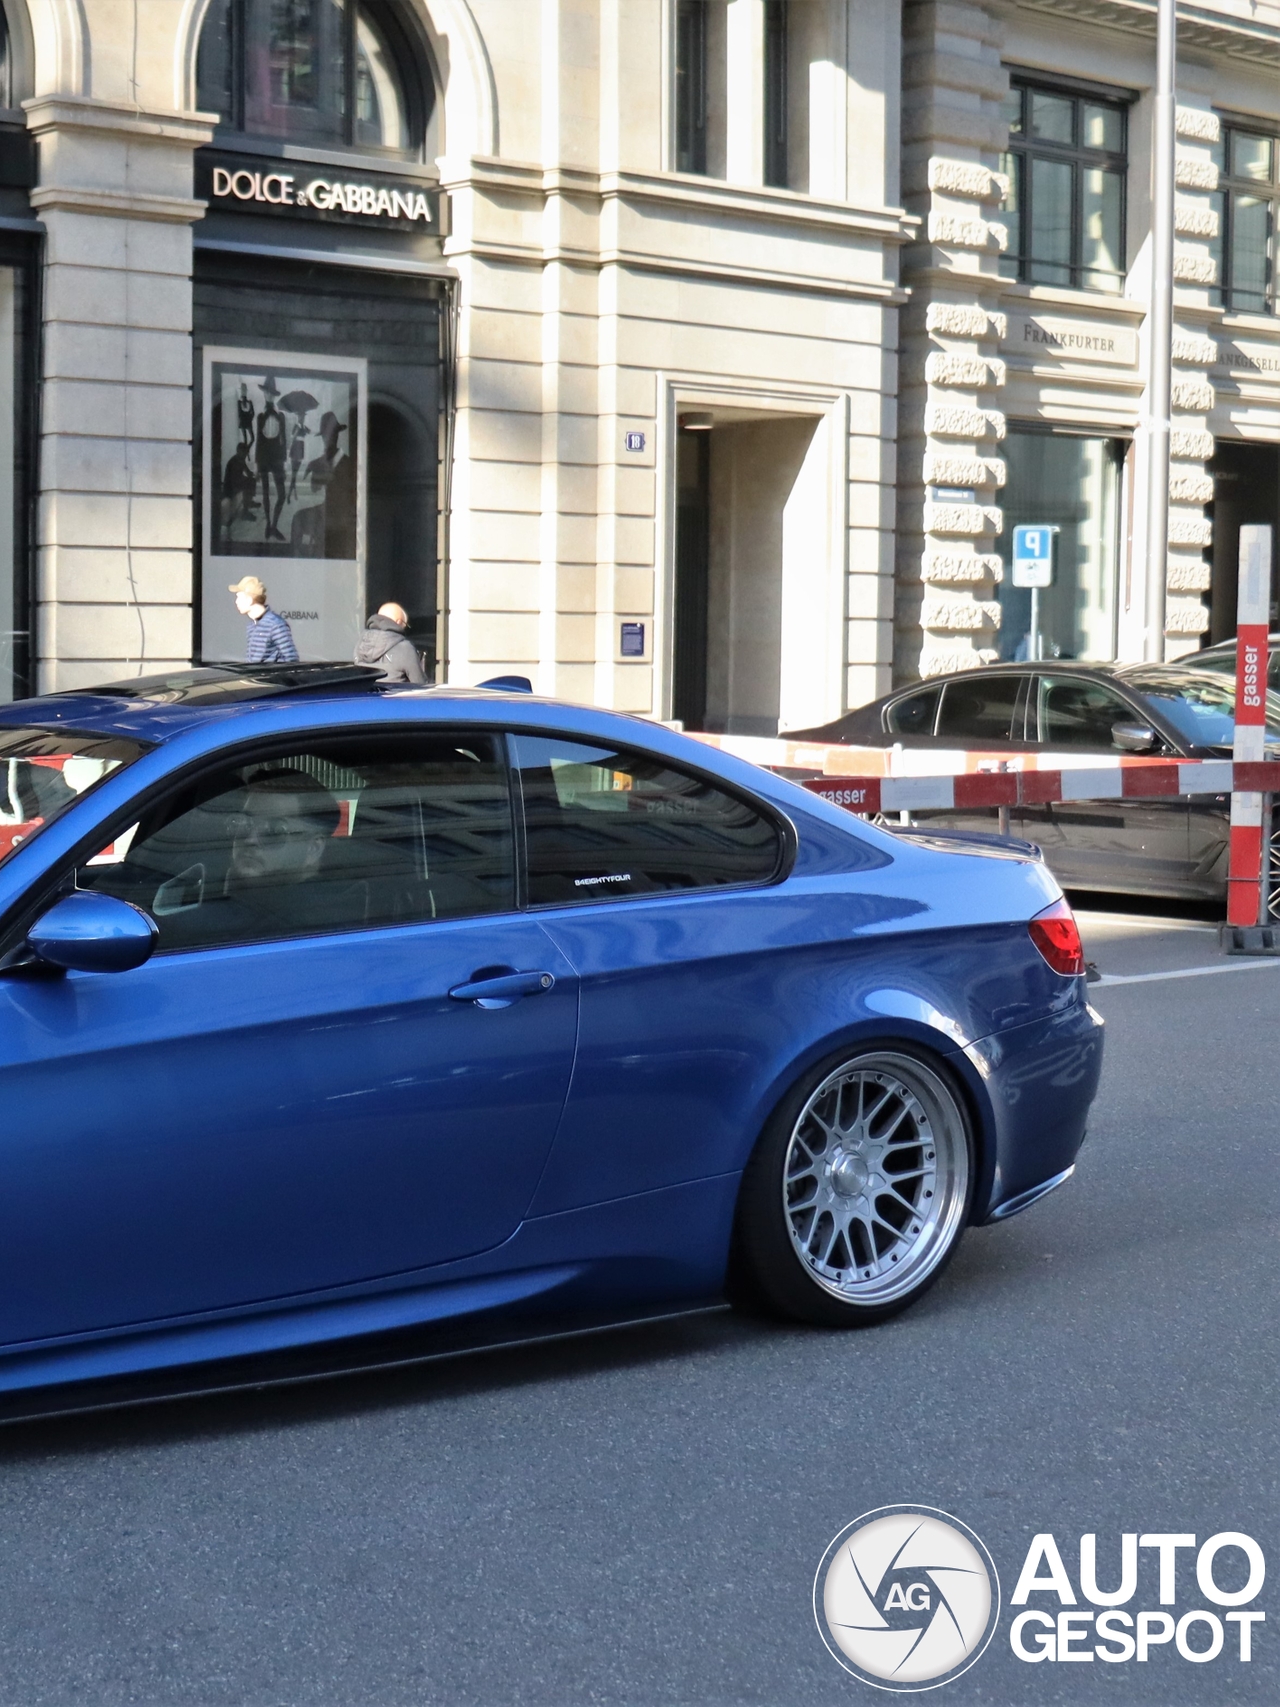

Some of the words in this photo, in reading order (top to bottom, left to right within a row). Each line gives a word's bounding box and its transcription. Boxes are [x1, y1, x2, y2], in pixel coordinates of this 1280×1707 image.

[213, 168, 295, 205] DOLCE
[296, 190, 308, 207] &
[306, 179, 432, 222] GABBANA
[1023, 324, 1115, 352] FRANKFURTER
[631, 434, 640, 449] 18
[1243, 645, 1260, 707] gasser
